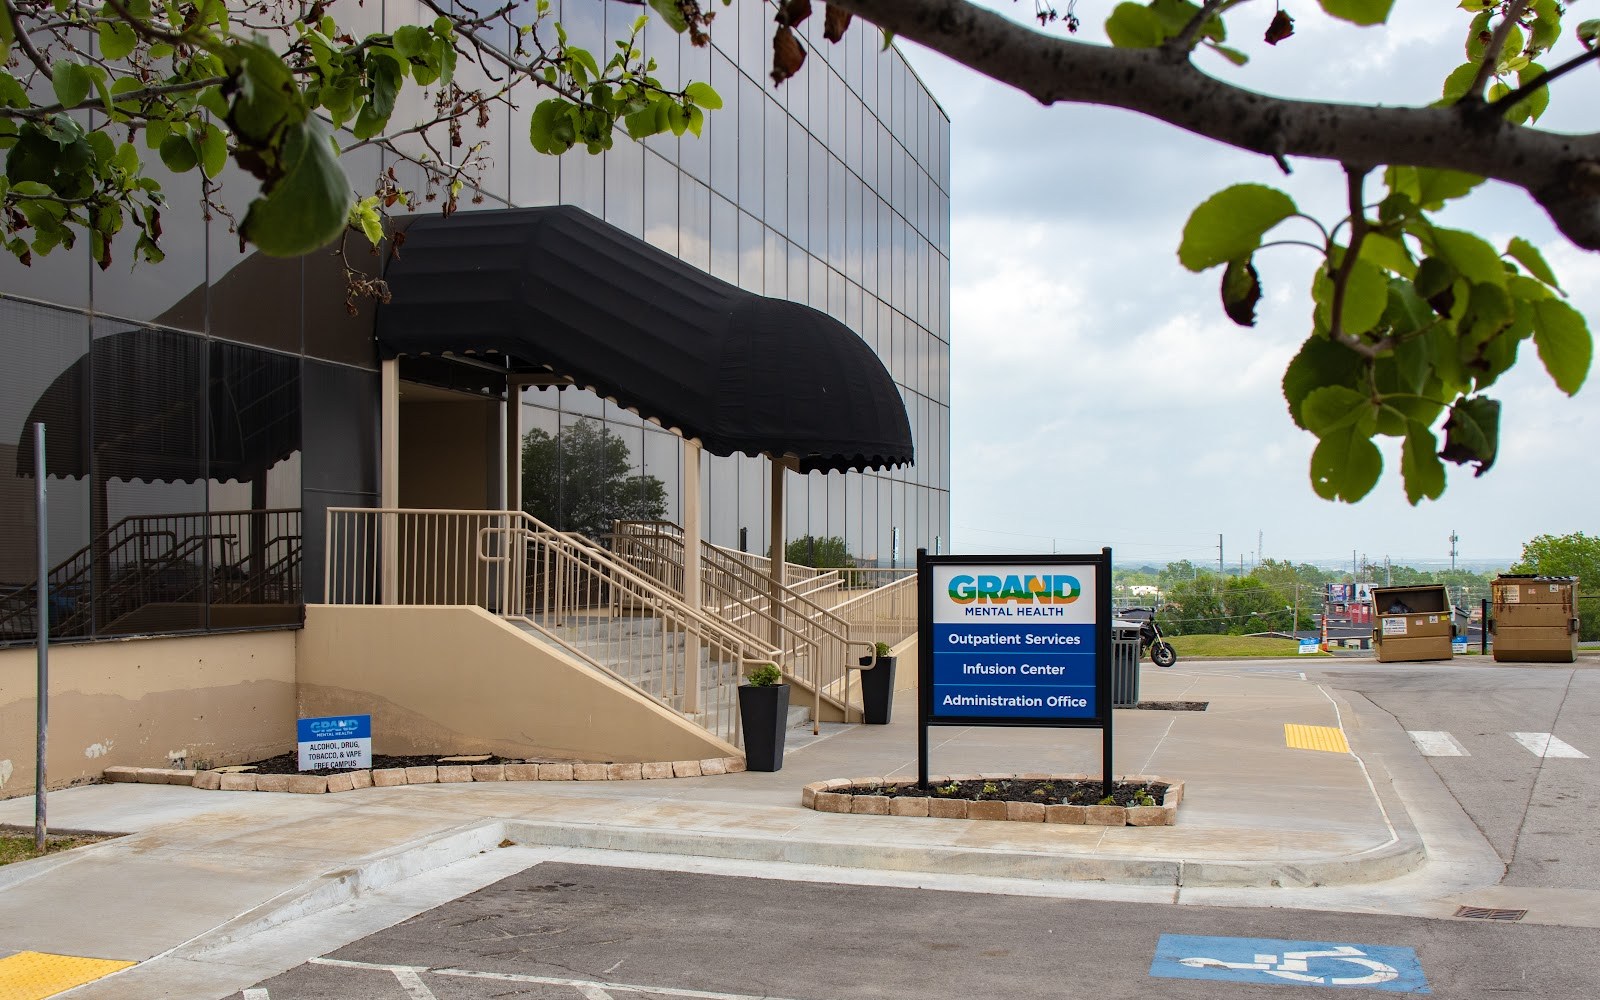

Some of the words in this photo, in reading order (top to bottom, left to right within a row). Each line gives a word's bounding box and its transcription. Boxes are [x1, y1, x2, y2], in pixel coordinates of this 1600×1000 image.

[948, 574, 1081, 605] GRAND
[965, 607, 1013, 616] MENTAL
[1017, 607, 1064, 617] HEALTH
[948, 633, 1021, 647] Outpatient
[1025, 633, 1081, 645] Services
[963, 663, 1016, 675] Infusion
[1020, 664, 1066, 675] Center
[942, 694, 1043, 707] Administration
[1046, 695, 1087, 708] Office
[310, 719, 359, 734] GRAND
[309, 742, 340, 751] ALCOHOL,
[341, 741, 360, 749] DRUG,
[308, 751, 339, 760] TOBACCO,
[346, 750, 362, 758] VAPE
[314, 761, 330, 769] FREE
[330, 760, 357, 769] CAMPUS
